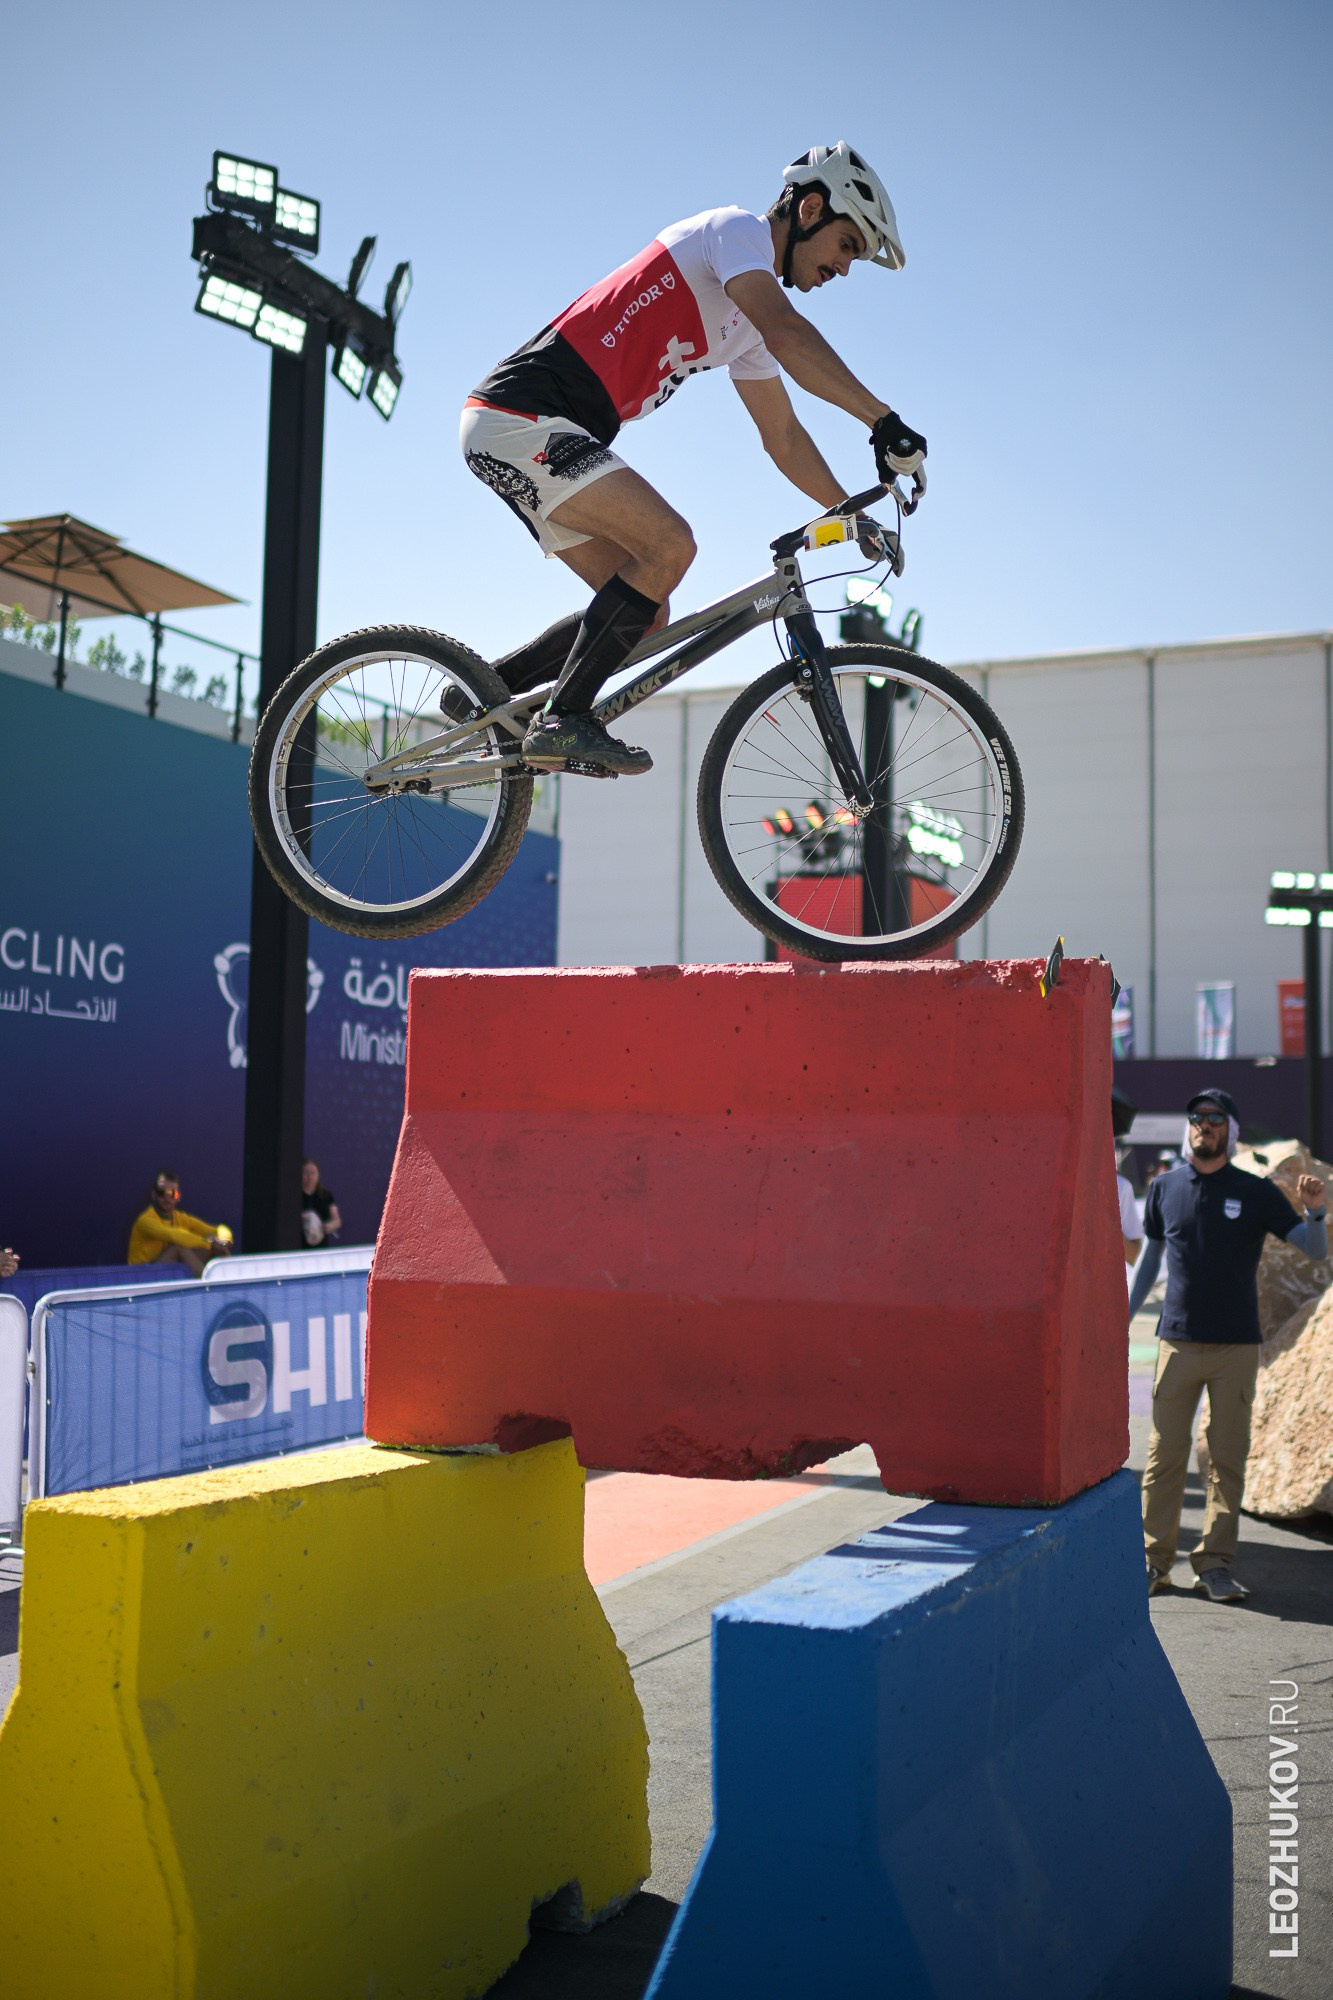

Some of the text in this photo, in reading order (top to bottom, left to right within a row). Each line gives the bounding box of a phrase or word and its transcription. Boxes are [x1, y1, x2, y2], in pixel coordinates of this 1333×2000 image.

[614, 284, 663, 334] TUDOR
[990, 737, 1005, 761] VEE
[1000, 761, 1012, 793] TIRE
